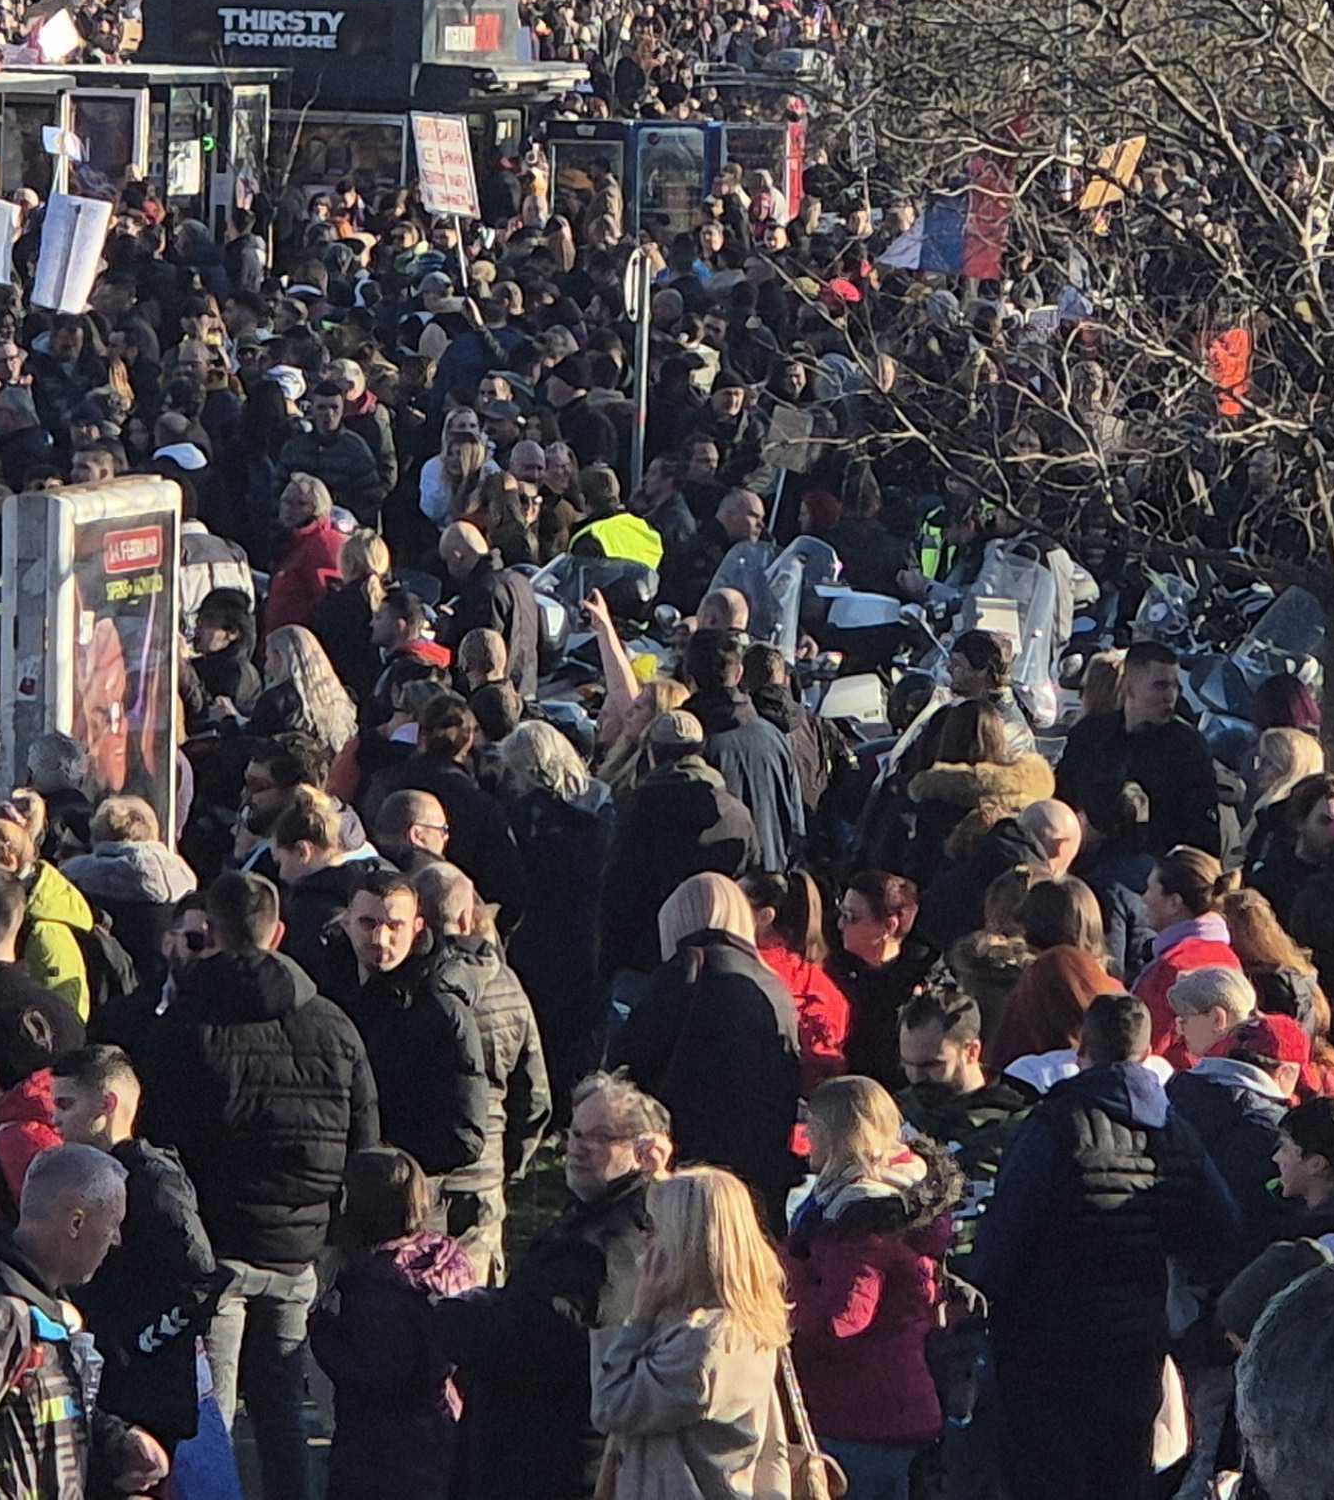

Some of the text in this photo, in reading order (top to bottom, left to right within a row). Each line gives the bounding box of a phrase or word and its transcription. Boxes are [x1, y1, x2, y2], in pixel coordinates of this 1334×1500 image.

[217, 7, 345, 33] THIRSTY
[223, 31, 338, 49] FOR MORE
